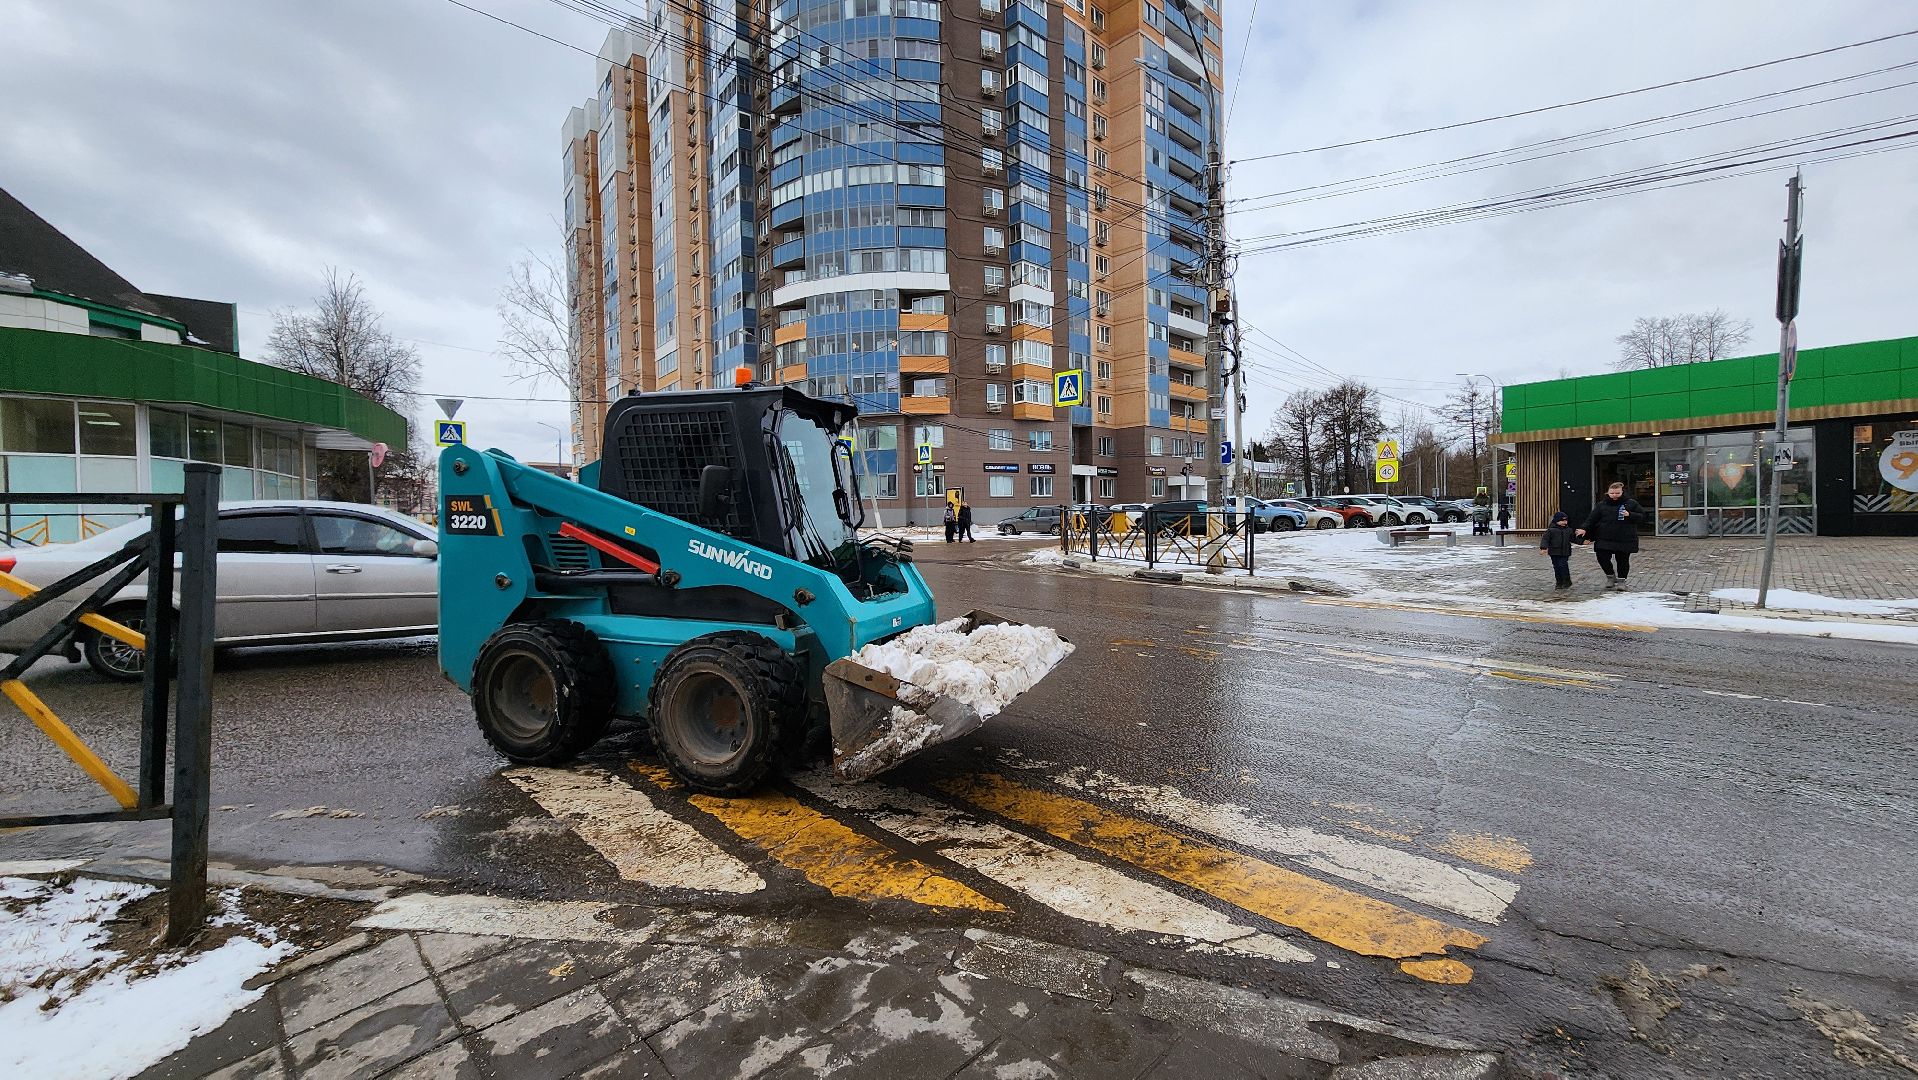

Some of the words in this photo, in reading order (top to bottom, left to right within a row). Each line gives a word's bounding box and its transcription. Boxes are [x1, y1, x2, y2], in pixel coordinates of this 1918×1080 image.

[450, 500, 474, 512] SWL
[450, 514, 487, 530] 3220
[688, 539, 773, 580] SUNWARD
